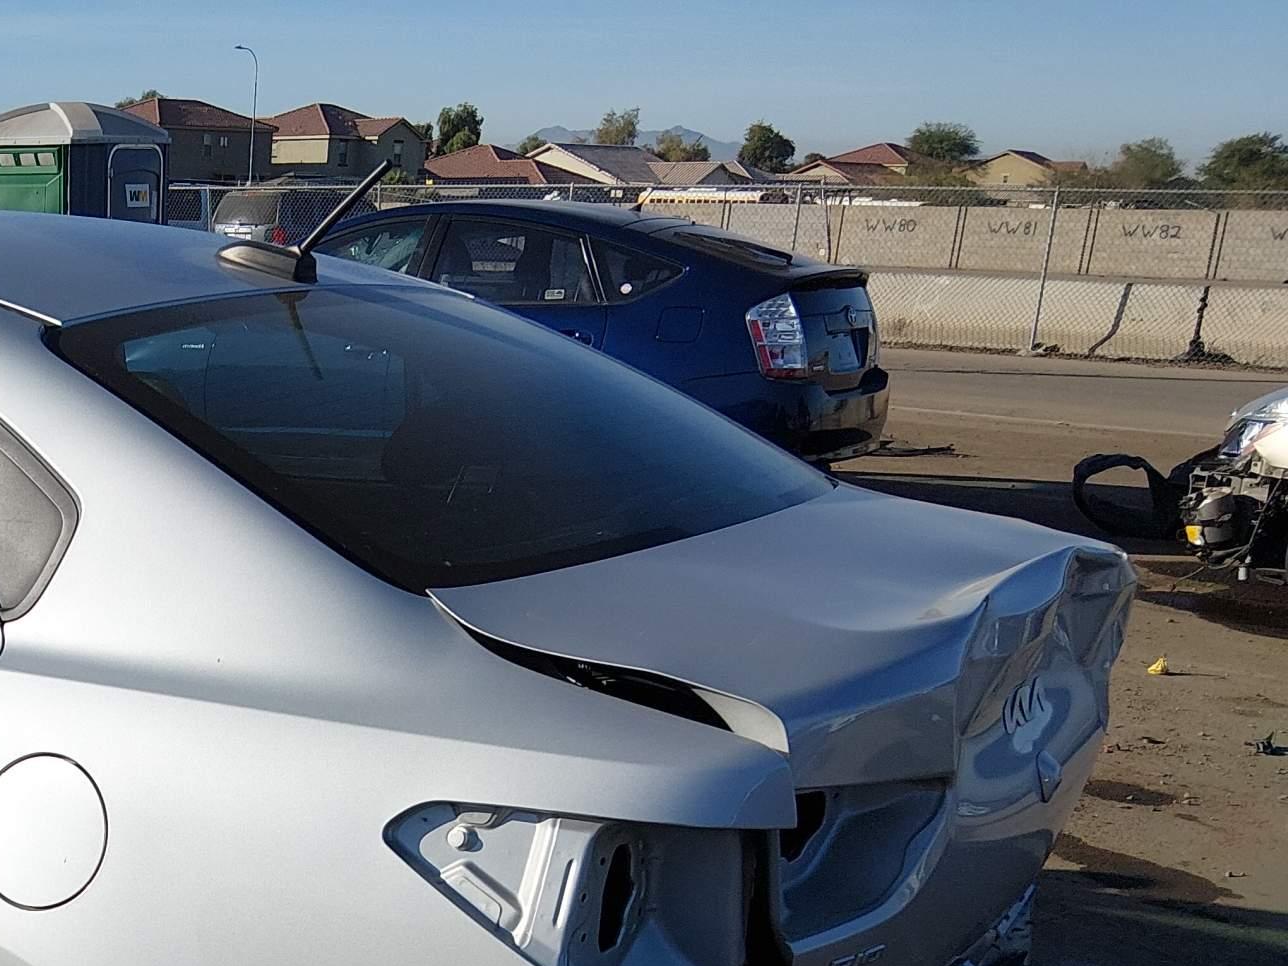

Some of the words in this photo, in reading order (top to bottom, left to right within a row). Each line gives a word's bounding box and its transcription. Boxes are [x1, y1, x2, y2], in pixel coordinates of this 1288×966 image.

[129, 190, 148, 202] WM
[864, 218, 918, 233] WW80
[987, 221, 1038, 236] WW81
[1122, 224, 1182, 240] WW82
